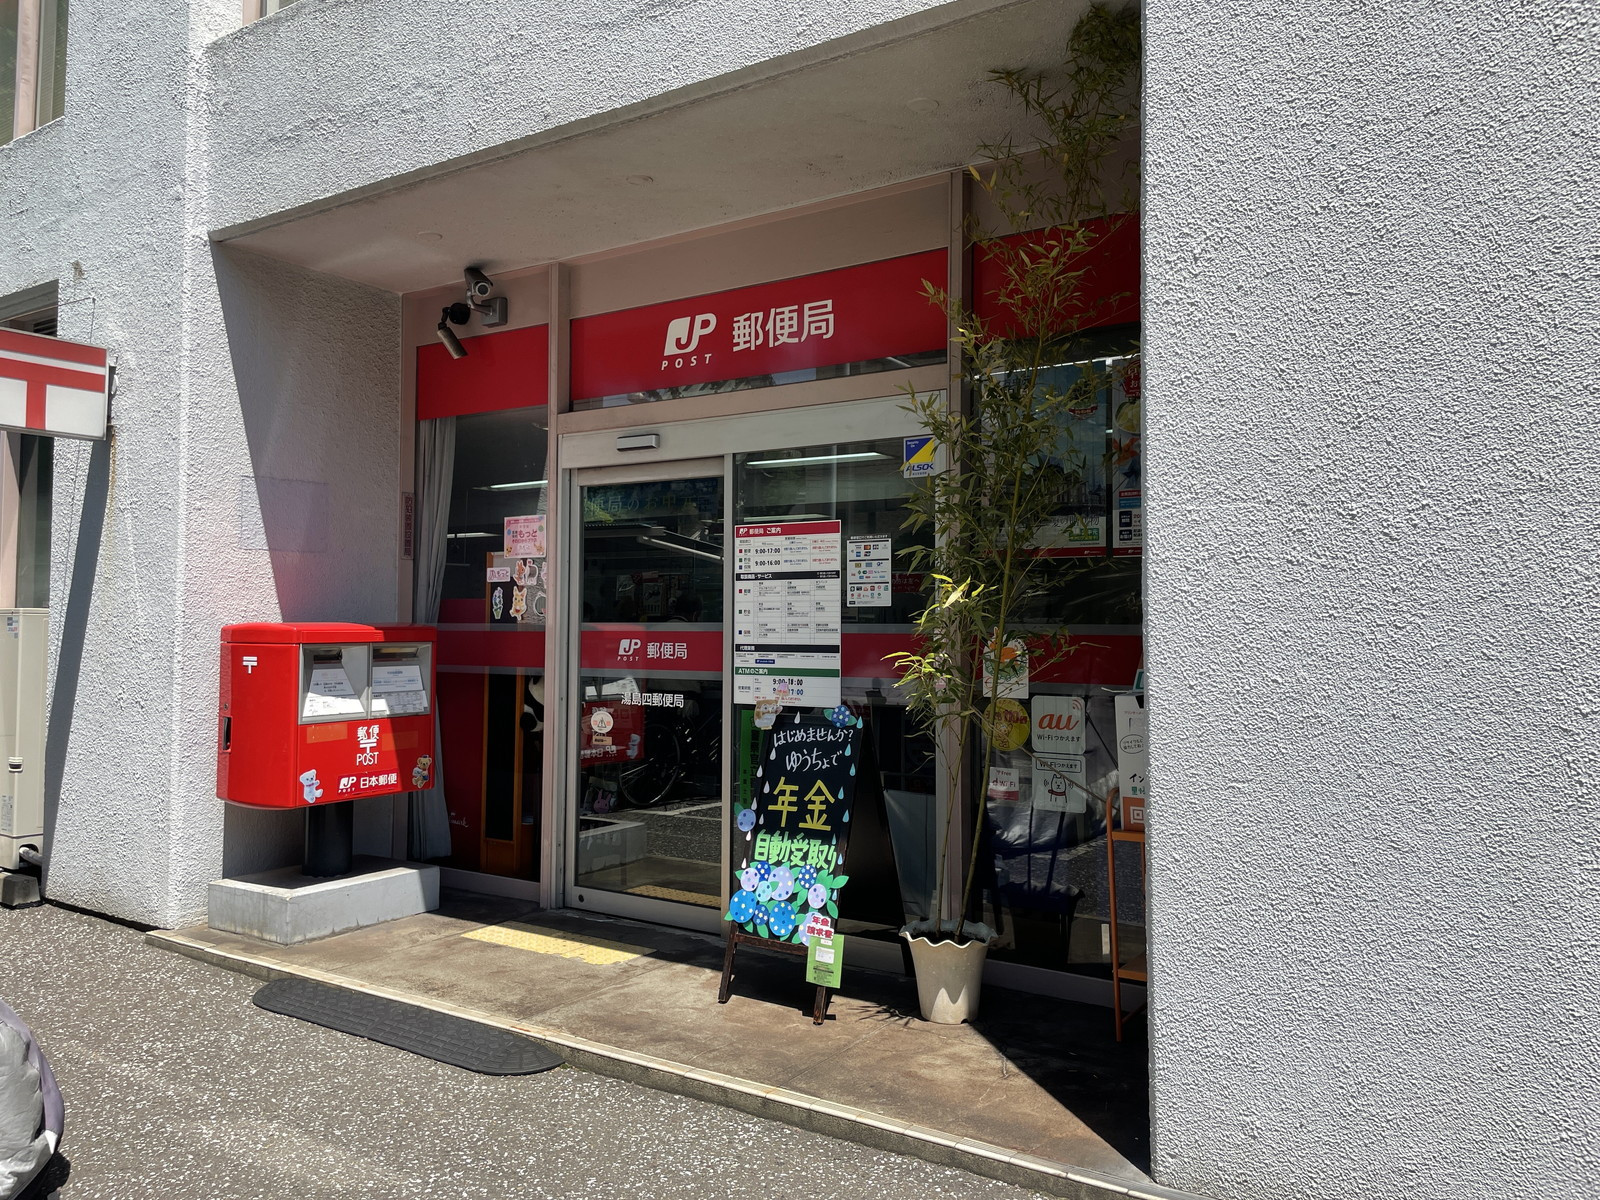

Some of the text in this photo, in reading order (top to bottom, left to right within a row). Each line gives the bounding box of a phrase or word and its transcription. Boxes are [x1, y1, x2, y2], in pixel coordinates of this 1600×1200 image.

[663, 299, 835, 356] JP 郵便局
[661, 353, 712, 371] POST
[906, 463, 934, 472] ALSOK
[518, 529, 538, 538] もっと
[755, 547, 781, 555] 9:00-17:00
[755, 559, 781, 567] 9:00-16:00
[618, 638, 688, 660] JP 郵便局
[621, 692, 685, 708] 湯島四郵便局
[1038, 713, 1080, 731] au
[357, 725, 380, 741] 郵便
[774, 727, 854, 749] はじめませんか?
[1037, 734, 1080, 742] Wi-Fiつかえます
[356, 752, 380, 766] POST
[785, 747, 842, 773] ゆうちょで
[360, 772, 398, 789] 日本郵便
[1129, 773, 1144, 783] イン
[768, 776, 836, 832] 年金
[754, 829, 837, 874] 自動受取り
[812, 915, 830, 927] 年金
[806, 925, 834, 939] 請求書
